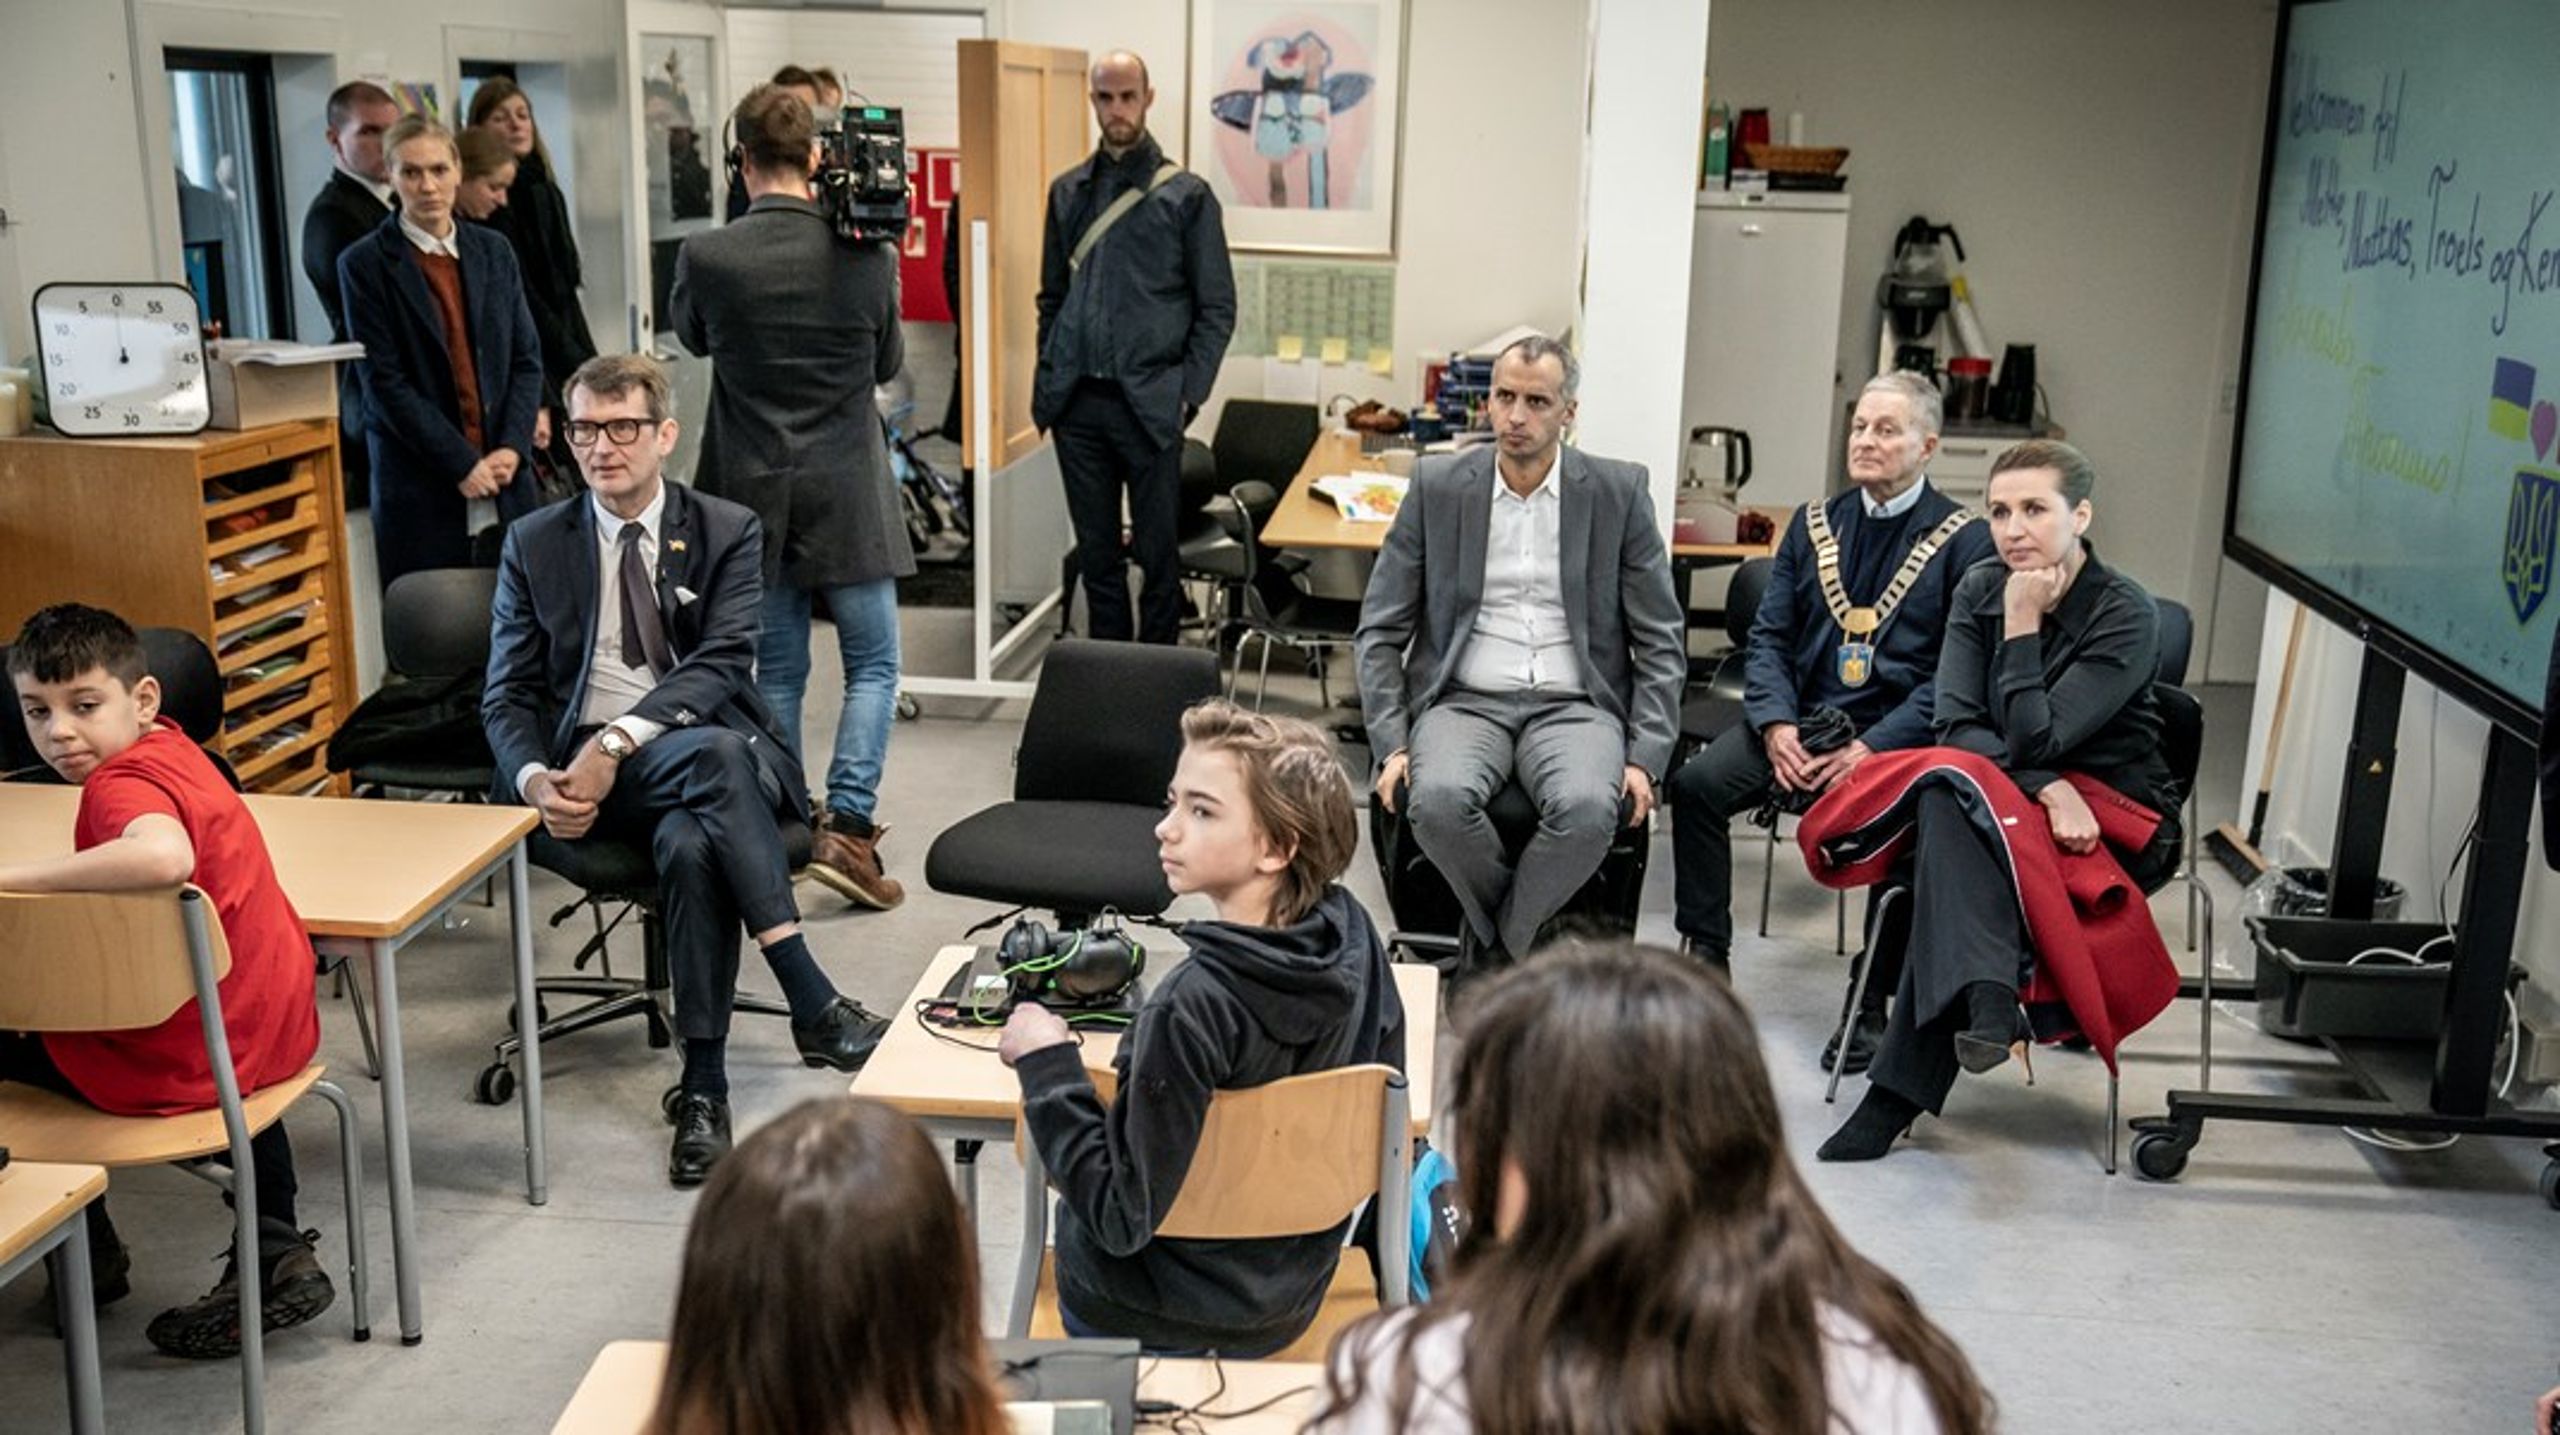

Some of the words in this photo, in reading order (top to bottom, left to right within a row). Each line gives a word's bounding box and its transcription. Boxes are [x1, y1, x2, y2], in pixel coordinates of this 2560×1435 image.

[2428, 159, 2485, 277] Troels
[2489, 247, 2516, 337] og
[78, 301, 88, 314] 5
[111, 294, 122, 308] 0
[146, 301, 164, 314] 55
[54, 323, 70, 336] 10
[172, 322, 190, 336] 50
[50, 353, 64, 366] 15
[181, 353, 199, 365] 45
[58, 382, 77, 396] 20
[83, 405, 102, 419] 25
[123, 413, 140, 427] 30
